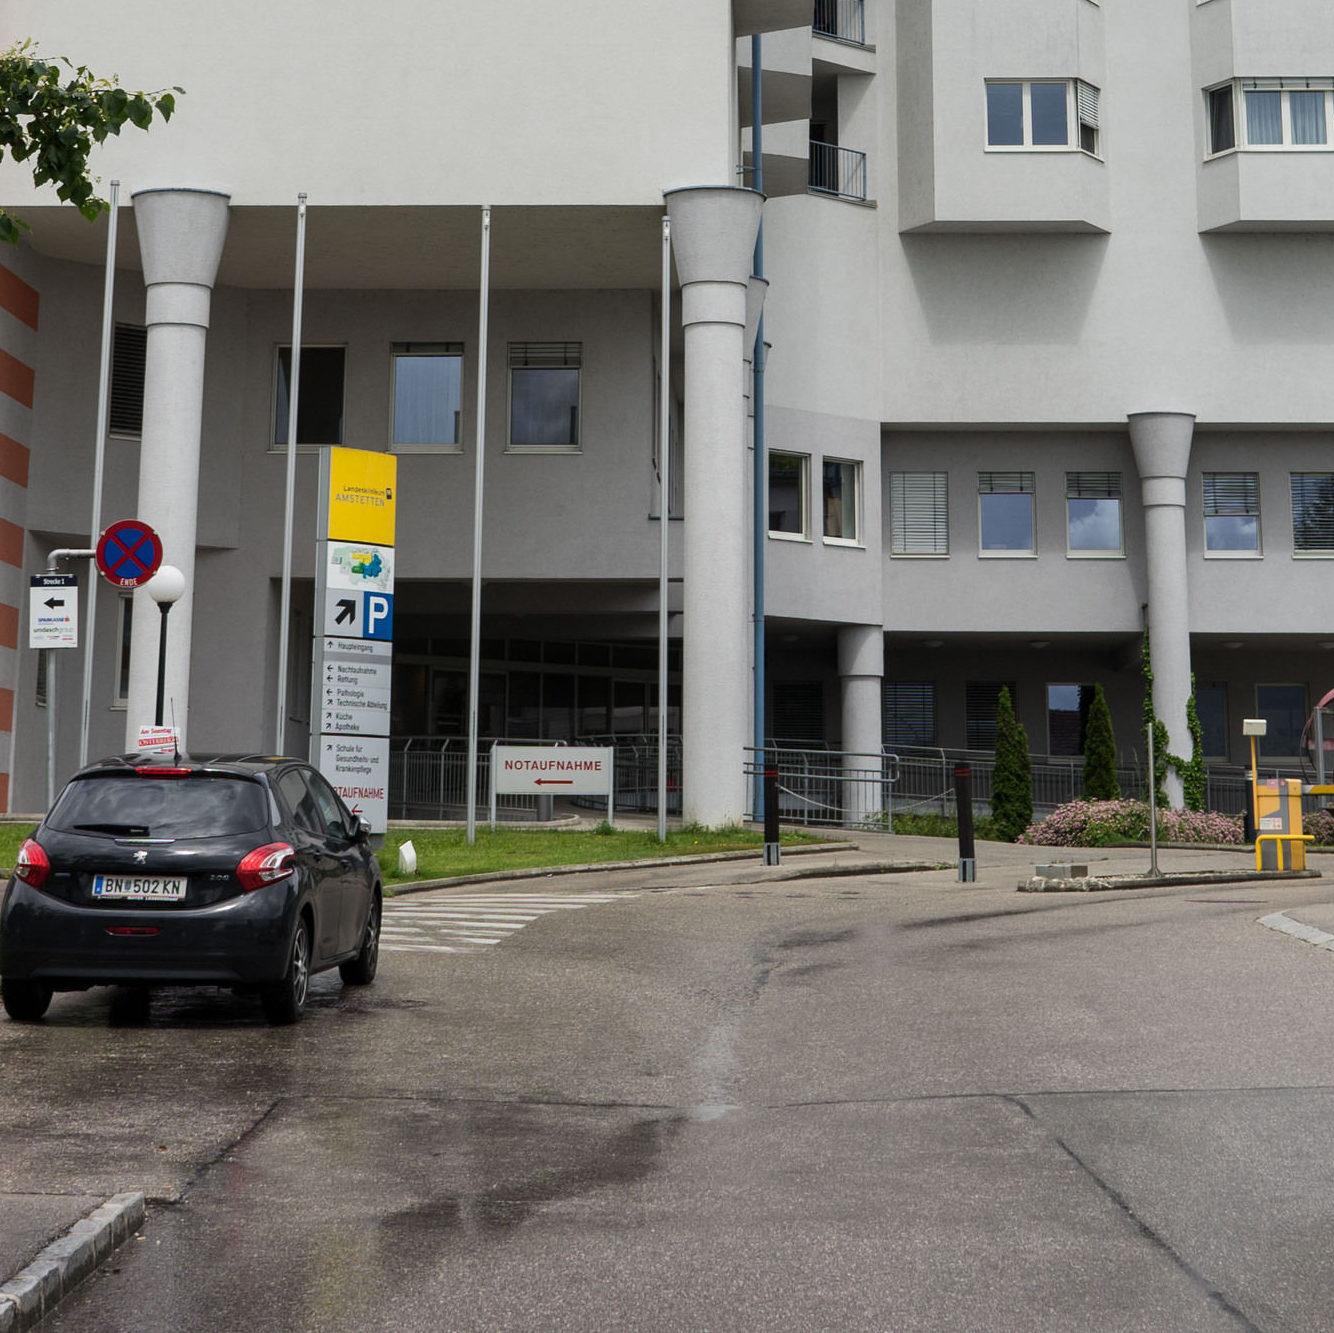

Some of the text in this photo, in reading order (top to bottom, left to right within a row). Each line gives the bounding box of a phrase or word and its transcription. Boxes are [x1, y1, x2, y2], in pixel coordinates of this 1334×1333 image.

[343, 485, 385, 496] Landesklinikum
[335, 493, 385, 506] AMSTETTEN
[120, 577, 138, 586] ENDE
[368, 595, 389, 634] P
[338, 641, 374, 653] Haupteingang
[337, 665, 377, 675] Nachtaufnahme
[337, 675, 358, 686] Rettung
[337, 688, 365, 699] Pathologie
[336, 698, 388, 711] Technische Abteilung
[335, 712, 353, 721] Küche
[335, 722, 360, 732] Apotheke
[336, 744, 363, 753] Schule für
[336, 754, 379, 764] Gesundheits- und
[335, 765, 372, 775] Krankenpflege
[504, 760, 602, 771] NOTAUFNAHME
[105, 877, 124, 893] BN
[133, 879, 160, 894] 502
[162, 879, 181, 895] KN
